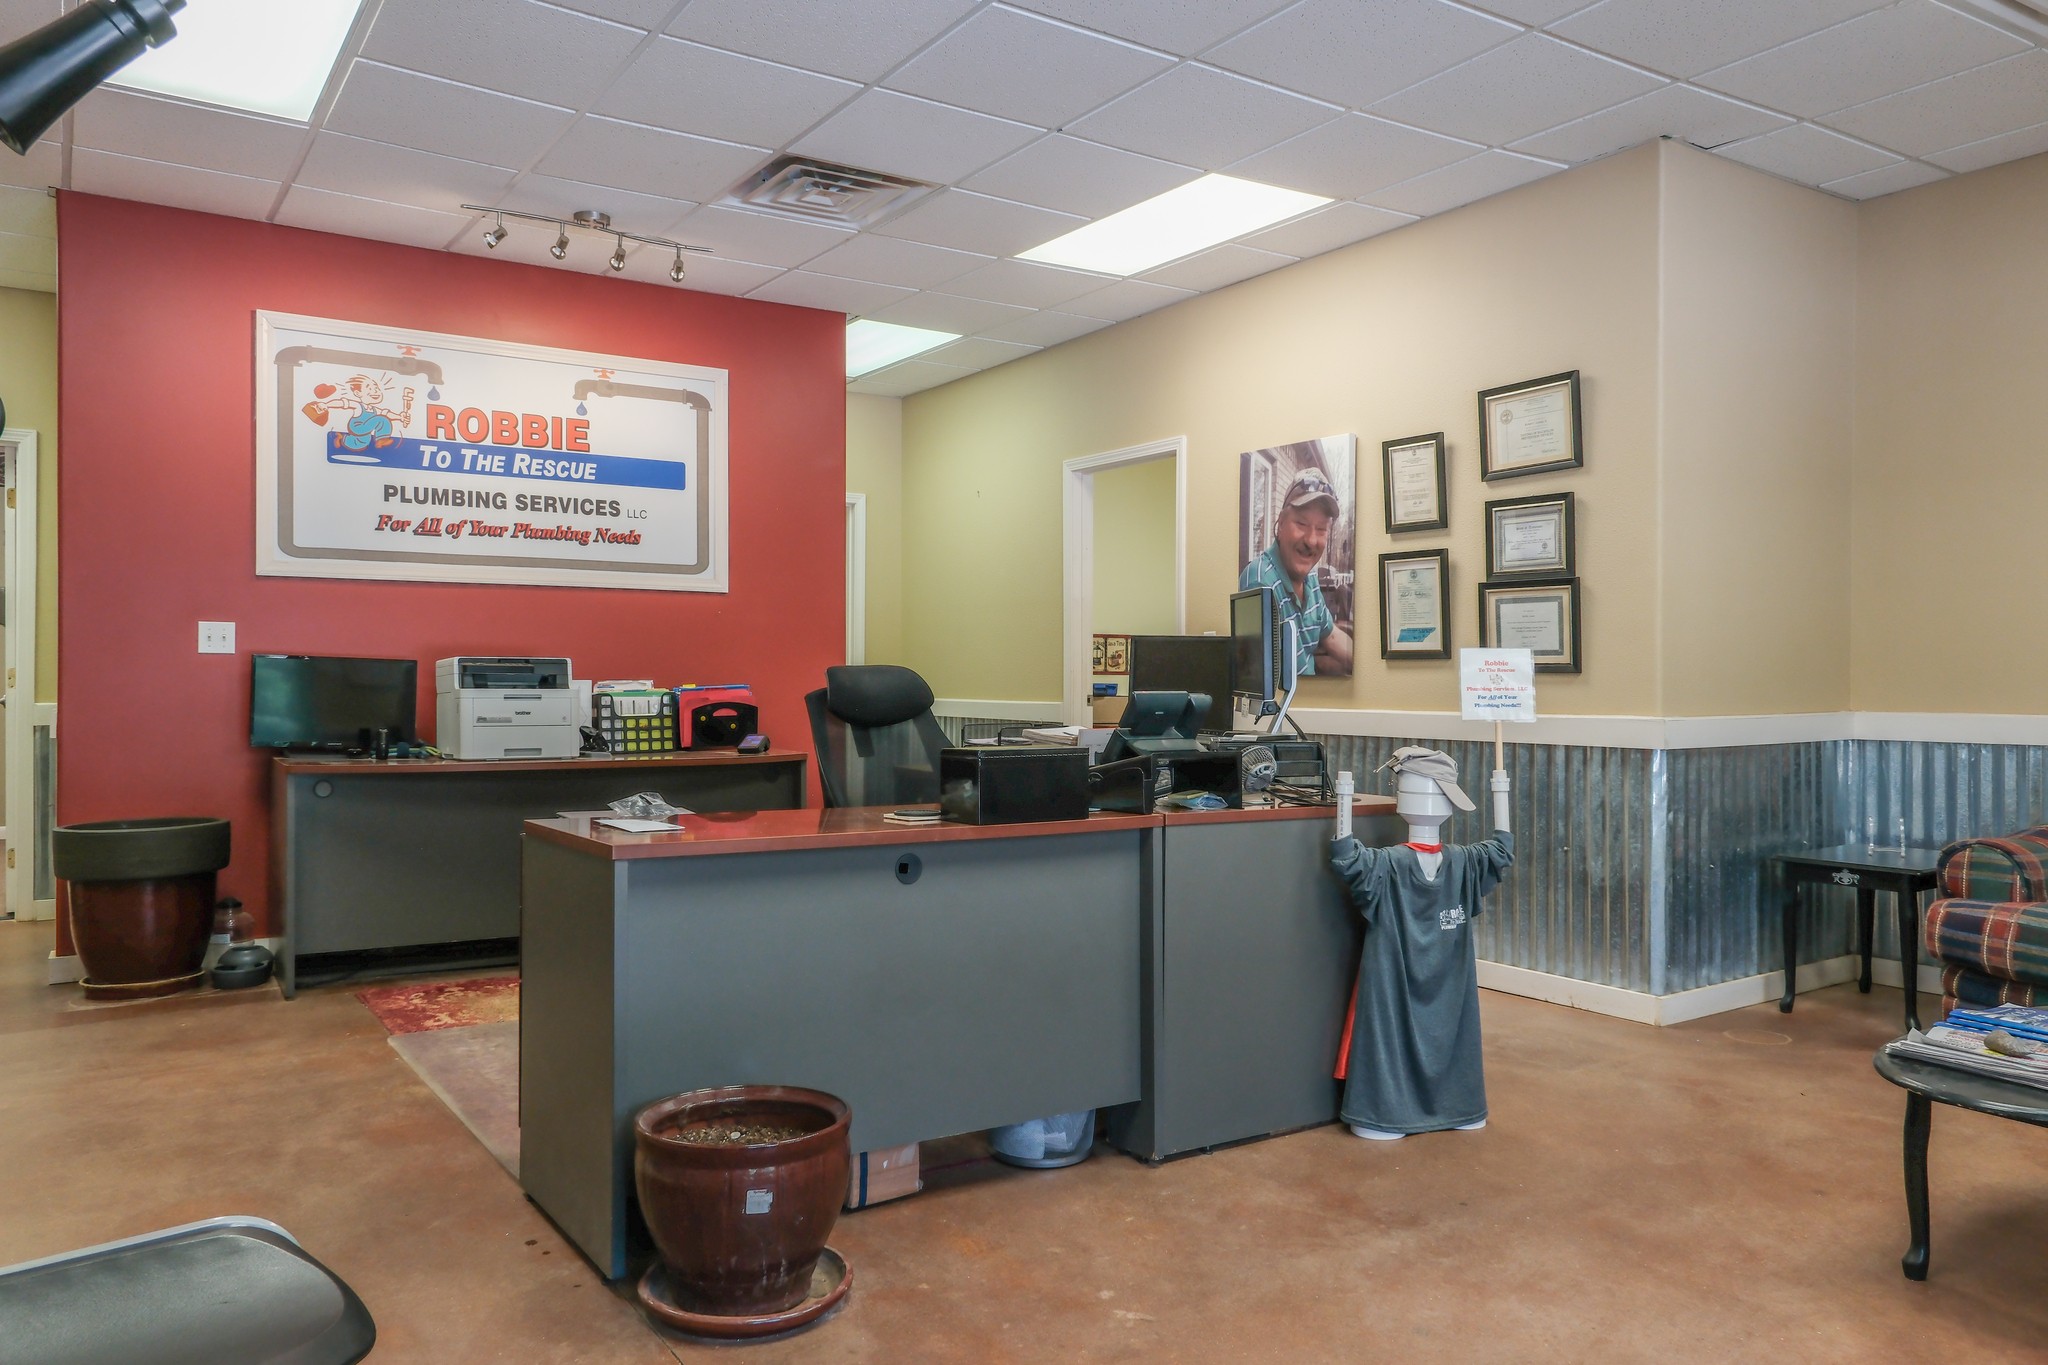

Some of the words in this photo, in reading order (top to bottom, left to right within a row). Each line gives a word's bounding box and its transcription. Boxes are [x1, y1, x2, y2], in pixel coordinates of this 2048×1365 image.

[426, 403, 591, 453] ROBBIE
[383, 484, 507, 510] PLUMBING
[515, 493, 621, 518] SERVICES
[626, 508, 648, 520] LLC
[375, 514, 412, 532] For
[412, 517, 443, 537] All
[445, 519, 468, 539] of
[468, 519, 509, 538] Your
[510, 522, 592, 546] Plumbing
[592, 527, 642, 545] Needs
